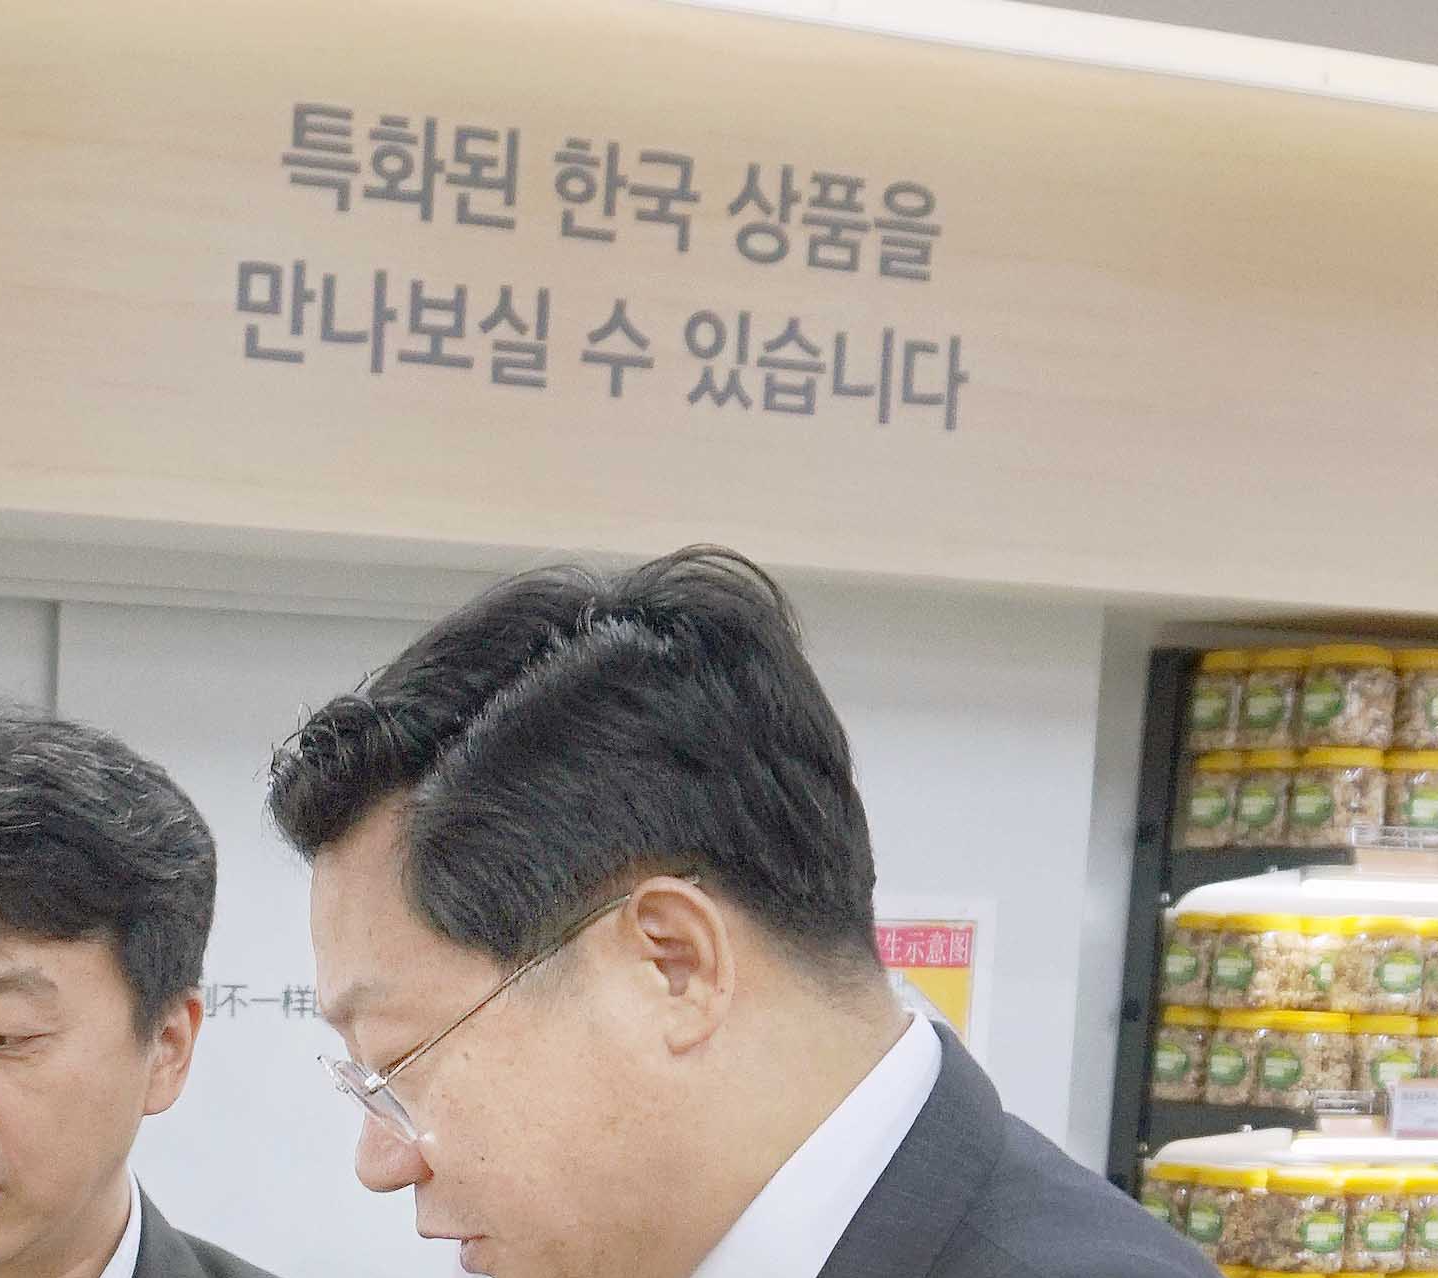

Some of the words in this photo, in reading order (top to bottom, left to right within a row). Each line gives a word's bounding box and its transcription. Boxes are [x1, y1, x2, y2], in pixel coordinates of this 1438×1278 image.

[281, 102, 522, 232] 특화된
[554, 137, 701, 253] 한국
[728, 161, 942, 282] 상품을
[235, 258, 551, 390] 만나보실
[581, 298, 654, 398] 수
[683, 308, 969, 431] 있습니다
[875, 930, 970, 965] 生示意图
[204, 984, 324, 1018] 不一样
